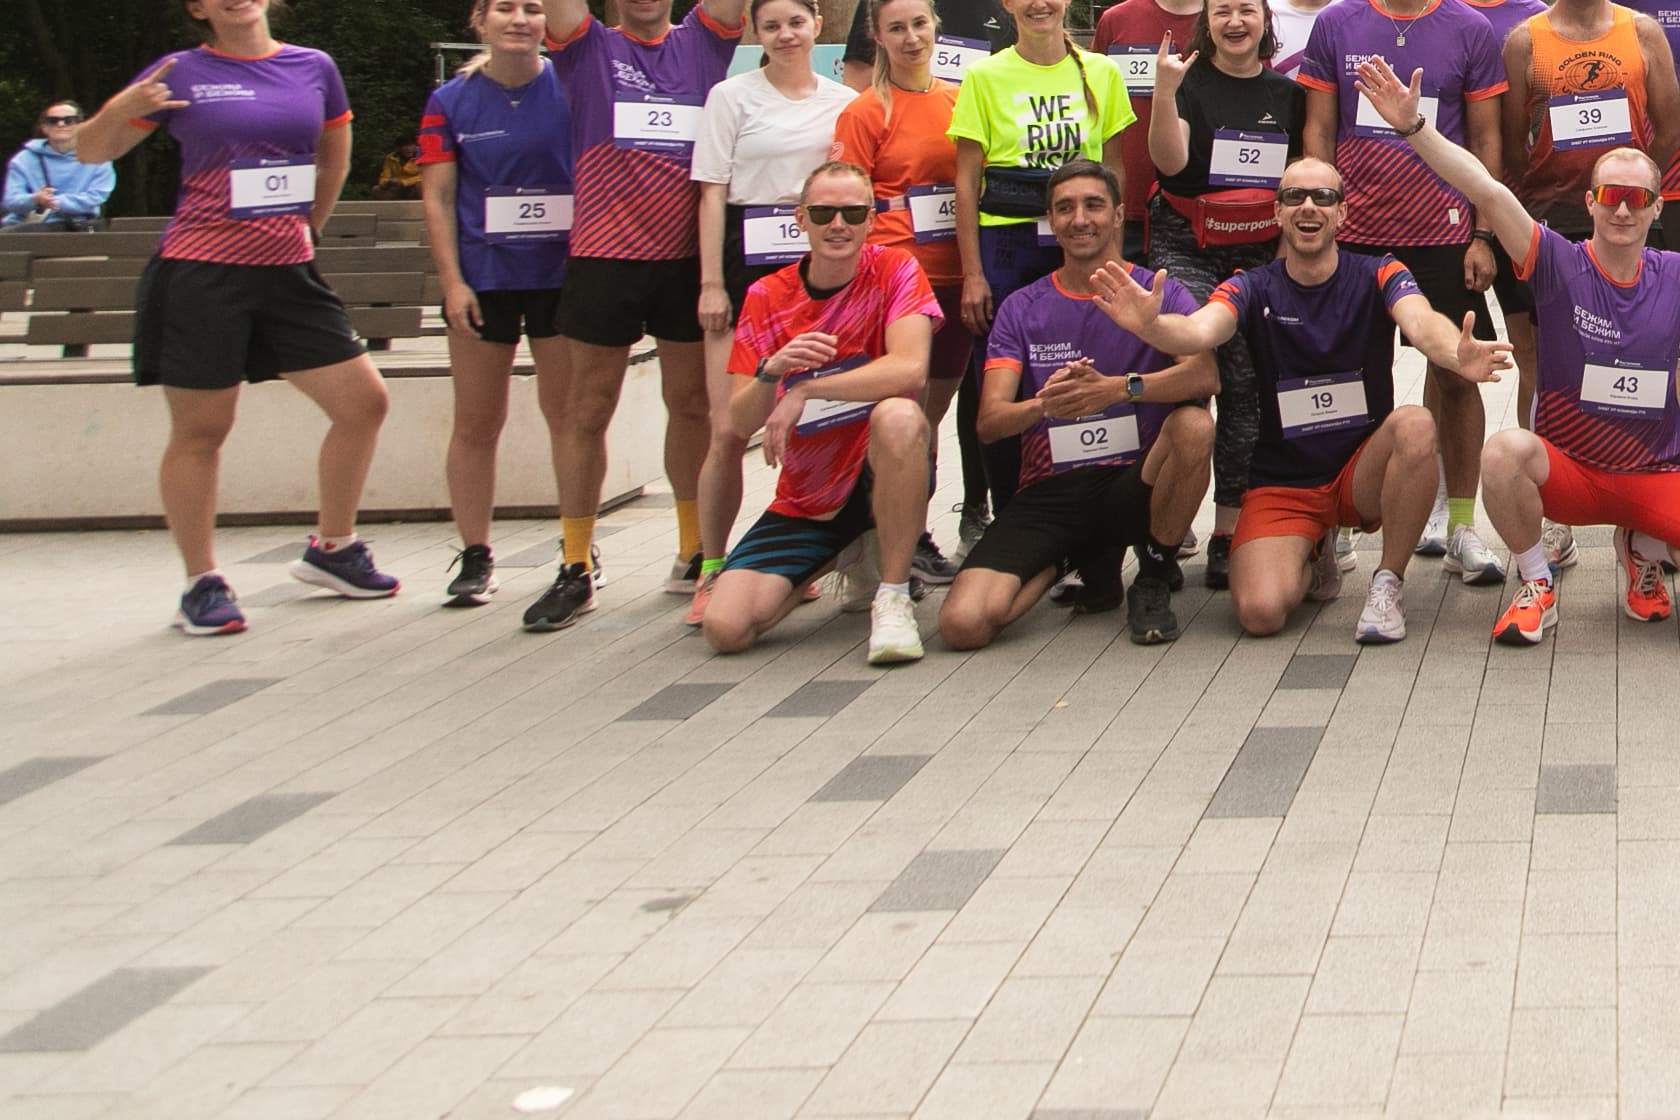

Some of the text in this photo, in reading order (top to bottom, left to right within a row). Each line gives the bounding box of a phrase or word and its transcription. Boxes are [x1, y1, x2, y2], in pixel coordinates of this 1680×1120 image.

[937, 51, 961, 68] 54
[1129, 60, 1149, 75] 32
[1558, 51, 1622, 71] GOLDEN RING
[1028, 94, 1074, 122] WE
[1578, 108, 1602, 125] 39
[647, 110, 673, 127] 23
[1027, 122, 1081, 151] RUN
[1238, 147, 1261, 164] 52
[265, 175, 288, 192] 01
[519, 202, 546, 219] 25
[778, 222, 801, 239] 16
[1574, 304, 1613, 329] БЕЖИМ
[1581, 319, 1621, 339] БЕЖИМ
[1029, 342, 1072, 353] БЕЖИМ
[1039, 349, 1082, 361] БЕЖИМ
[1613, 375, 1639, 394] 43
[1311, 391, 1333, 409] 19
[1080, 427, 1108, 446] 02
